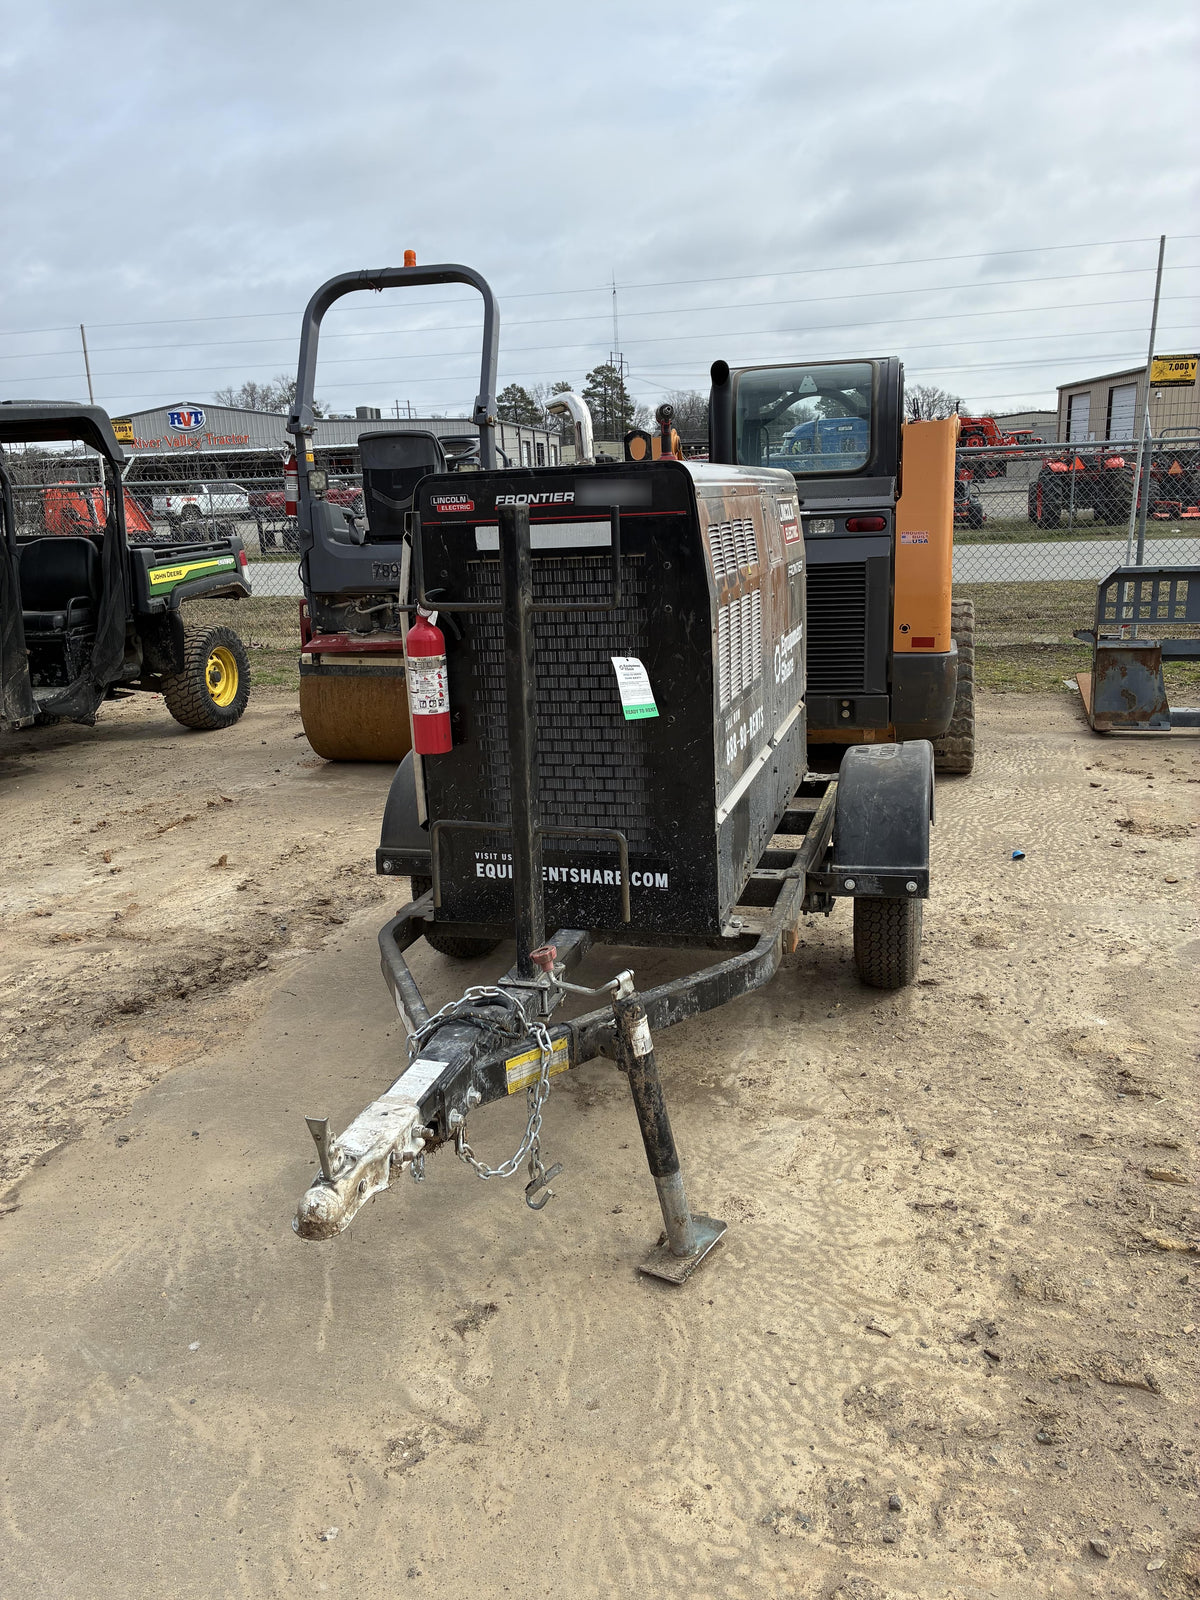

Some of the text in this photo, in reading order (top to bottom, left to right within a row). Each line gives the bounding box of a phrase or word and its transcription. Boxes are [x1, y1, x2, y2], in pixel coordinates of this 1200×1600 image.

[1168, 363, 1189, 371] 7,000
[168, 411, 203, 427] RVT
[131, 433, 250, 449] River Valley Tractor
[432, 496, 466, 504] LINCOLN
[495, 491, 576, 505] FRONTIER
[153, 570, 182, 581] JOHN DEERE
[475, 852, 513, 861] VISIT US
